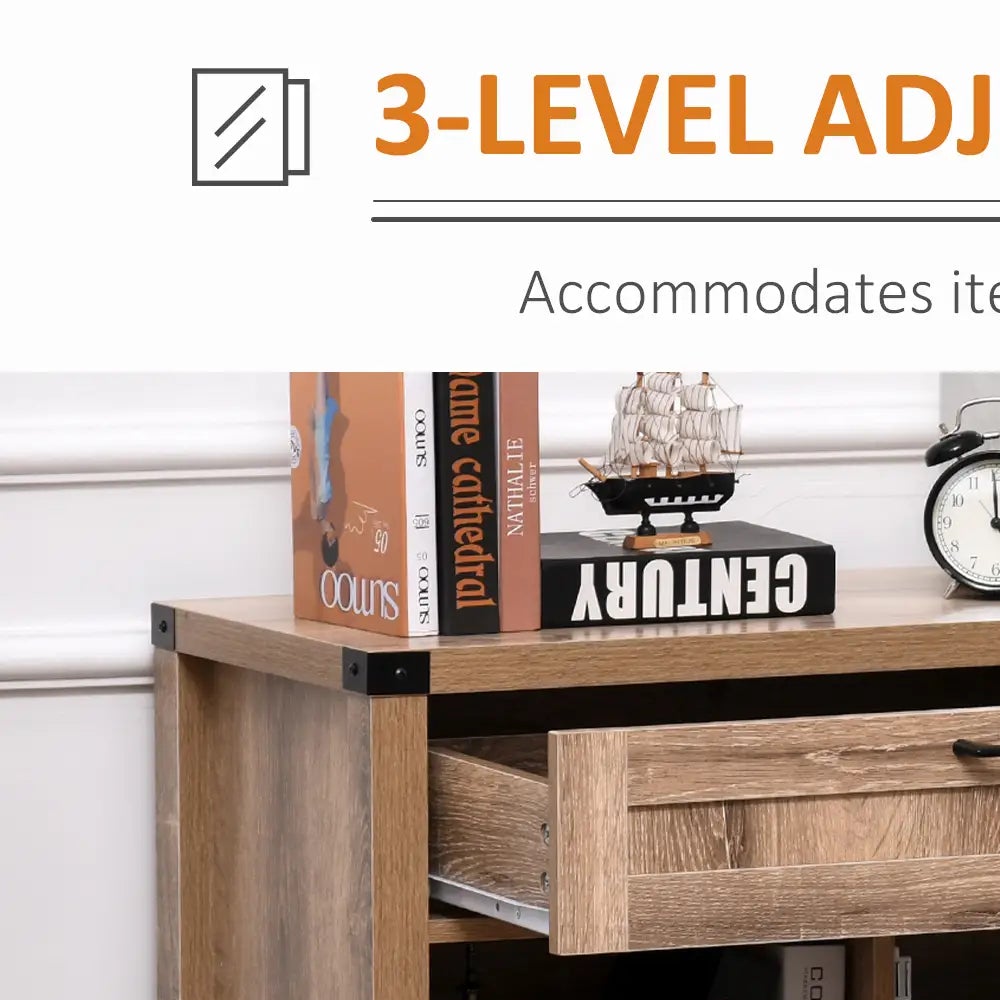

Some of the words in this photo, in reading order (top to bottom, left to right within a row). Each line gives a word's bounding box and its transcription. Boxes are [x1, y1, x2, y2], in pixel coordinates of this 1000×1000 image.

[449, 372, 484, 446] ame
[506, 437, 524, 537] NATHALIE
[968, 476, 979, 490] 11
[951, 493, 964, 508] 10
[942, 516, 952, 529] 9
[451, 456, 497, 611] cathedral
[950, 539, 960, 553] 8
[969, 556, 978, 570] 7
[991, 563, 1000, 577] 6
[570, 553, 807, 622] CENTURY
